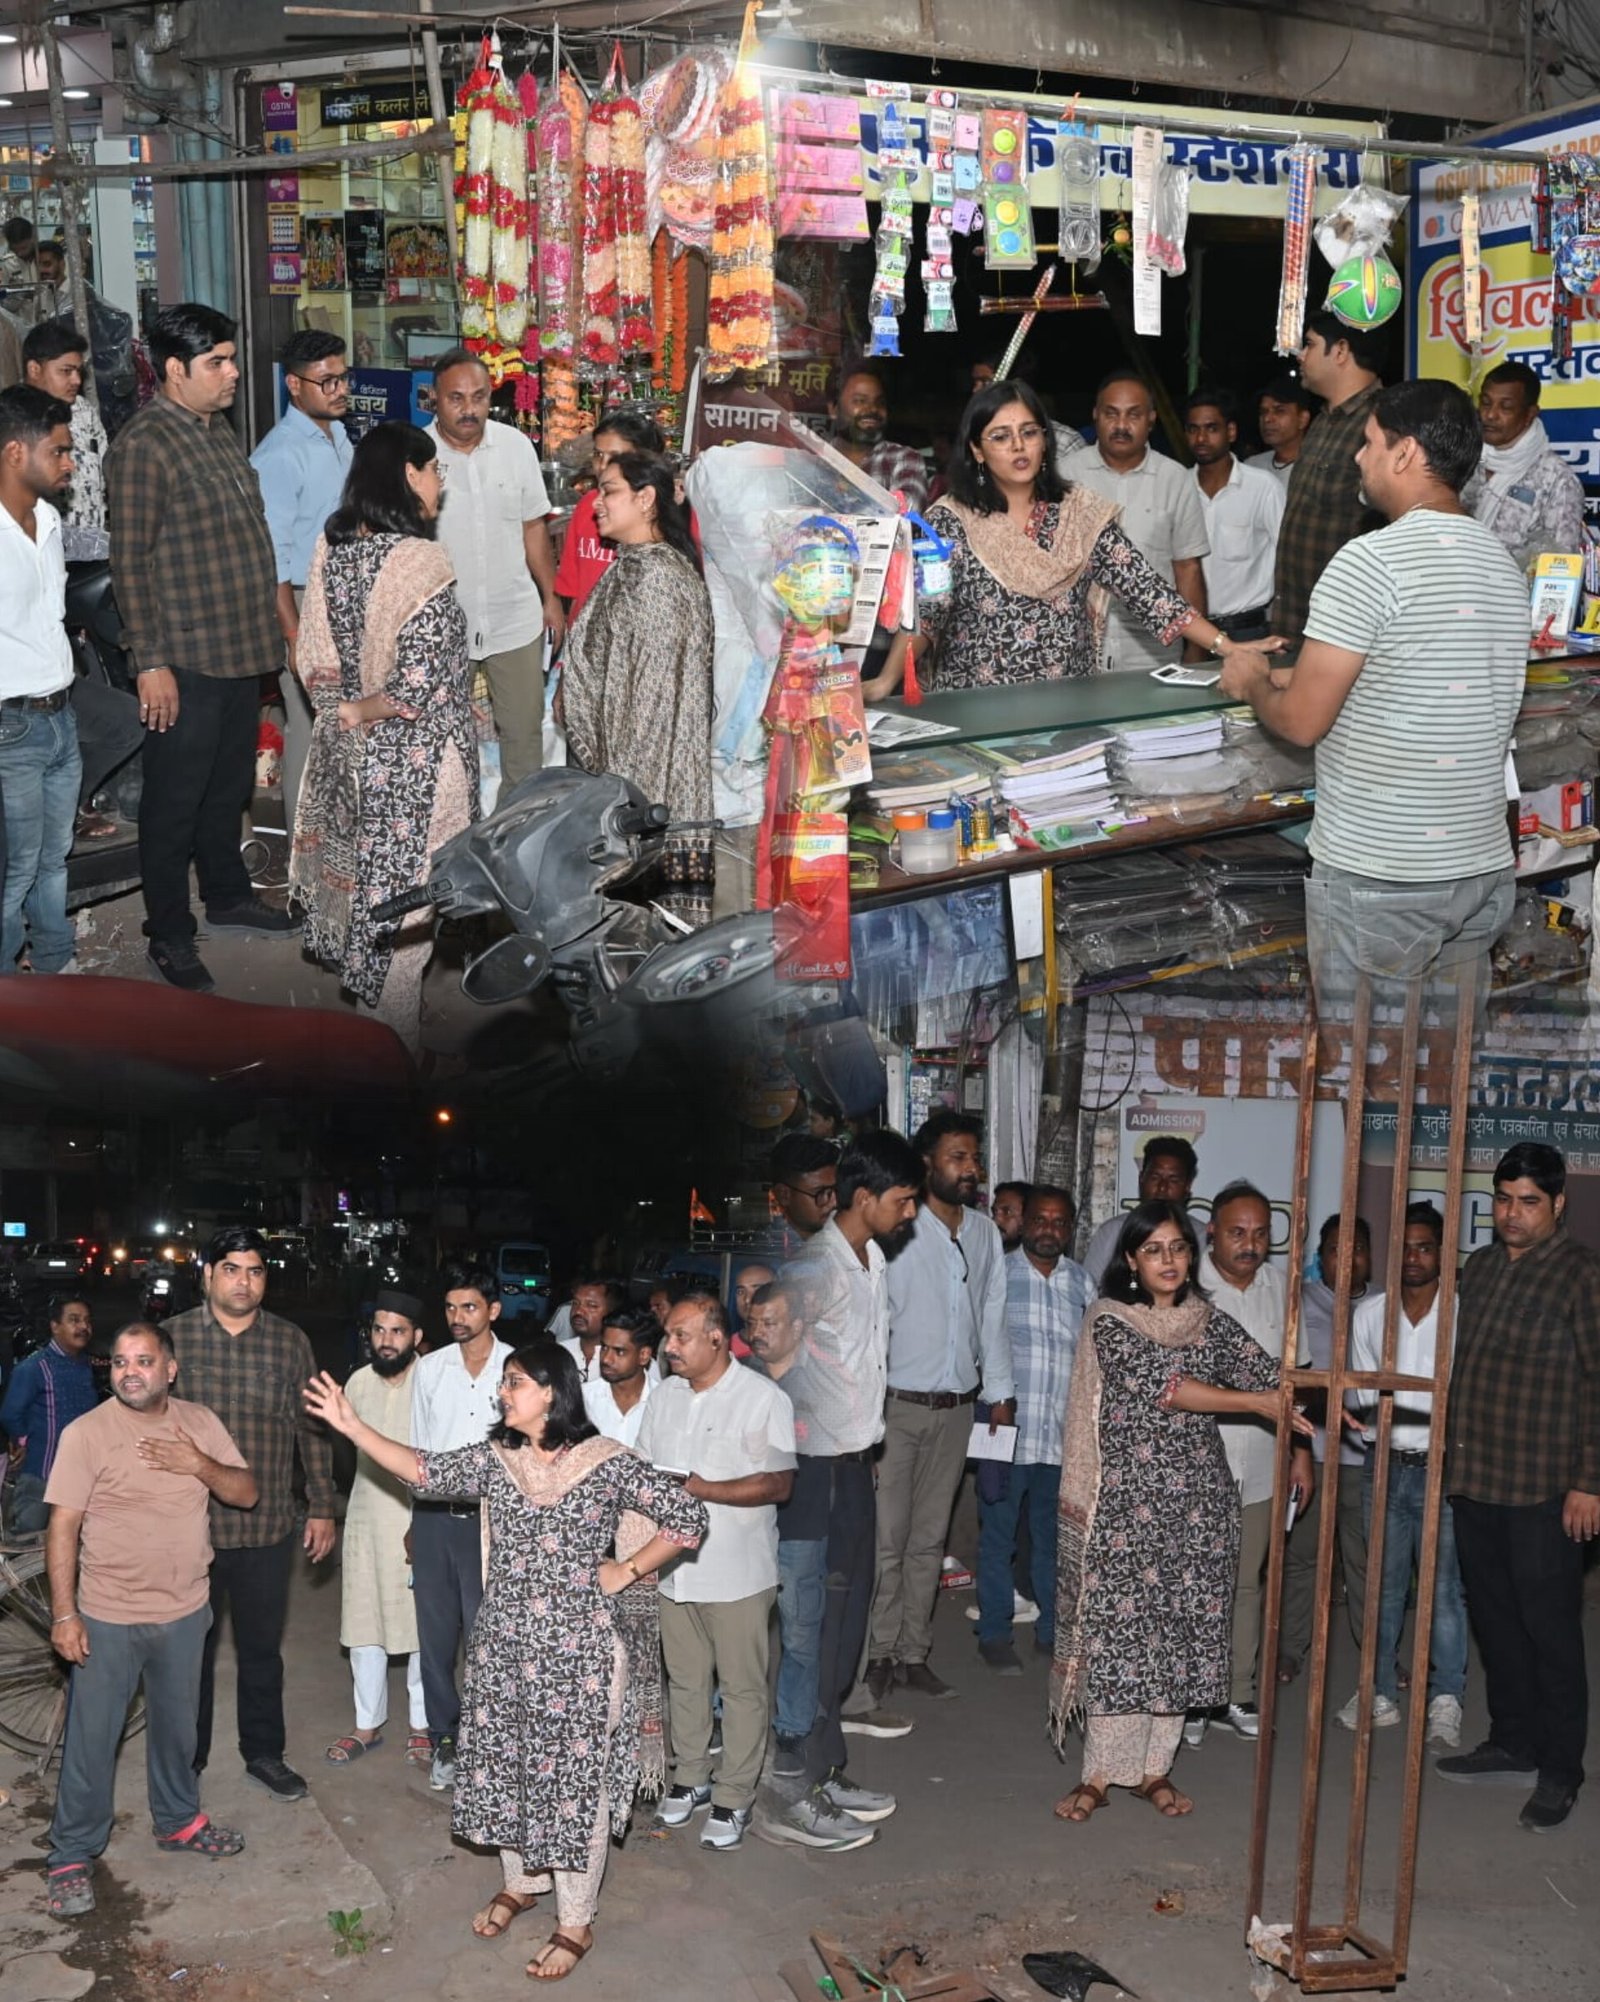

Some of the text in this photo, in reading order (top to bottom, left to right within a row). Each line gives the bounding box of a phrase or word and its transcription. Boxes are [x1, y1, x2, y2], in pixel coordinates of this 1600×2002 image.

[271, 102, 291, 110] GSTIN
[375, 98, 409, 115] कलर
[703, 403, 781, 432] सामान
[1131, 1114, 1201, 1127] ADMISSION
